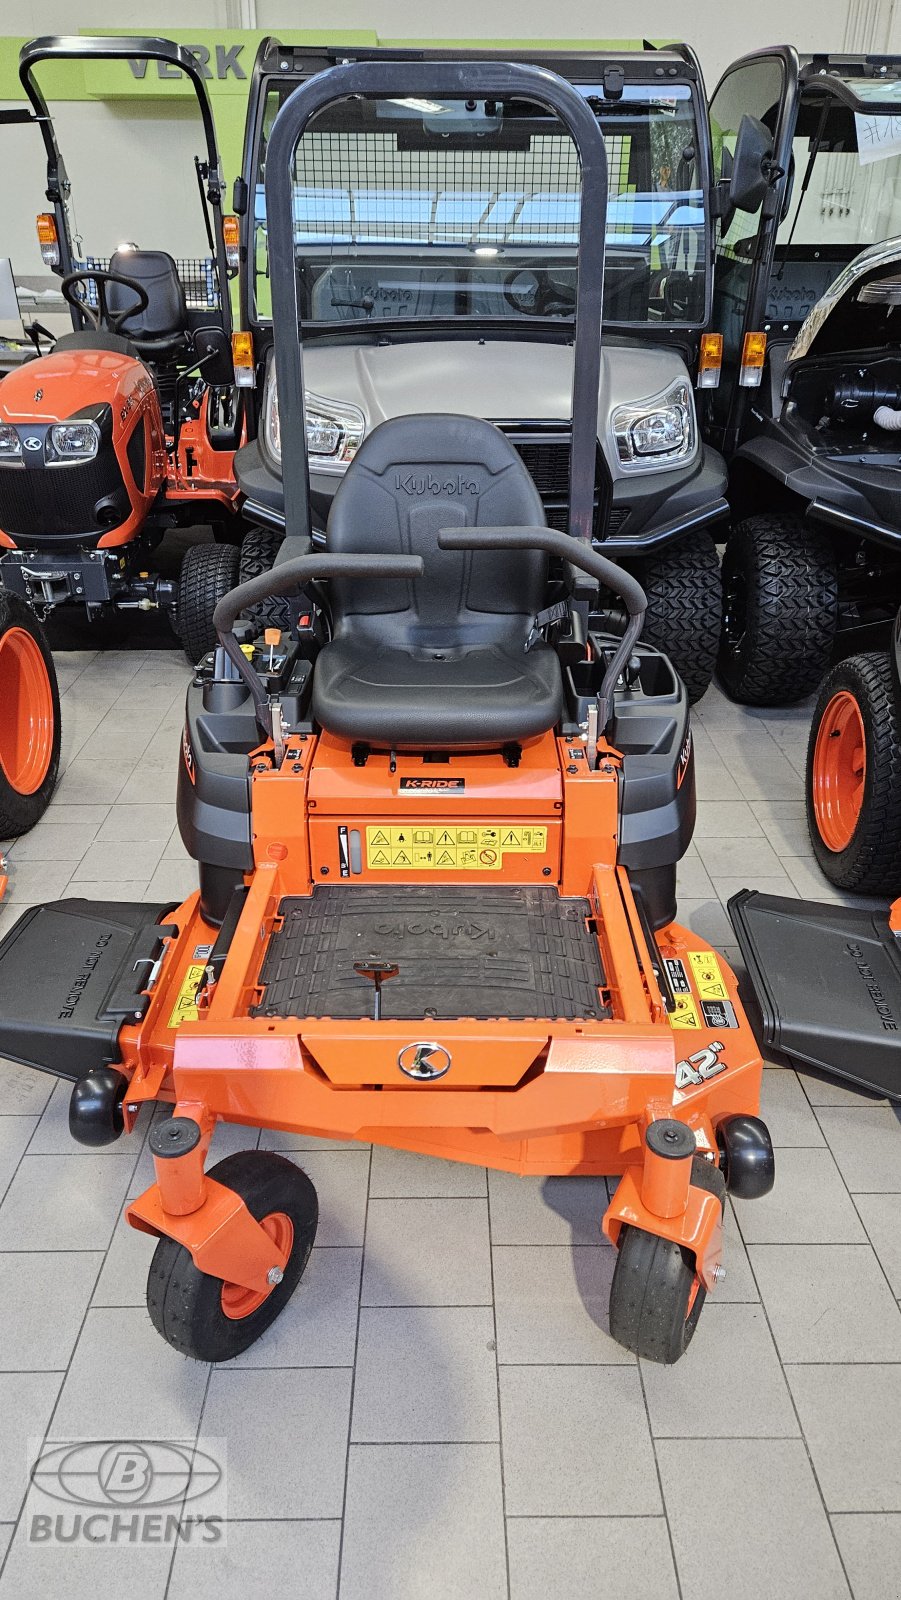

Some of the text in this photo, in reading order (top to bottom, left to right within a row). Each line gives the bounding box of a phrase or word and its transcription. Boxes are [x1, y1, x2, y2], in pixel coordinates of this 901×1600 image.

[394, 474, 480, 496] Kubota
[405, 780, 460, 788] K-RIDE
[374, 922, 495, 940] Kubota
[82, 951, 103, 971] NOT
[856, 961, 877, 982] NOT
[58, 972, 92, 1020] REMOVE
[866, 983, 899, 1031] REMOVE
